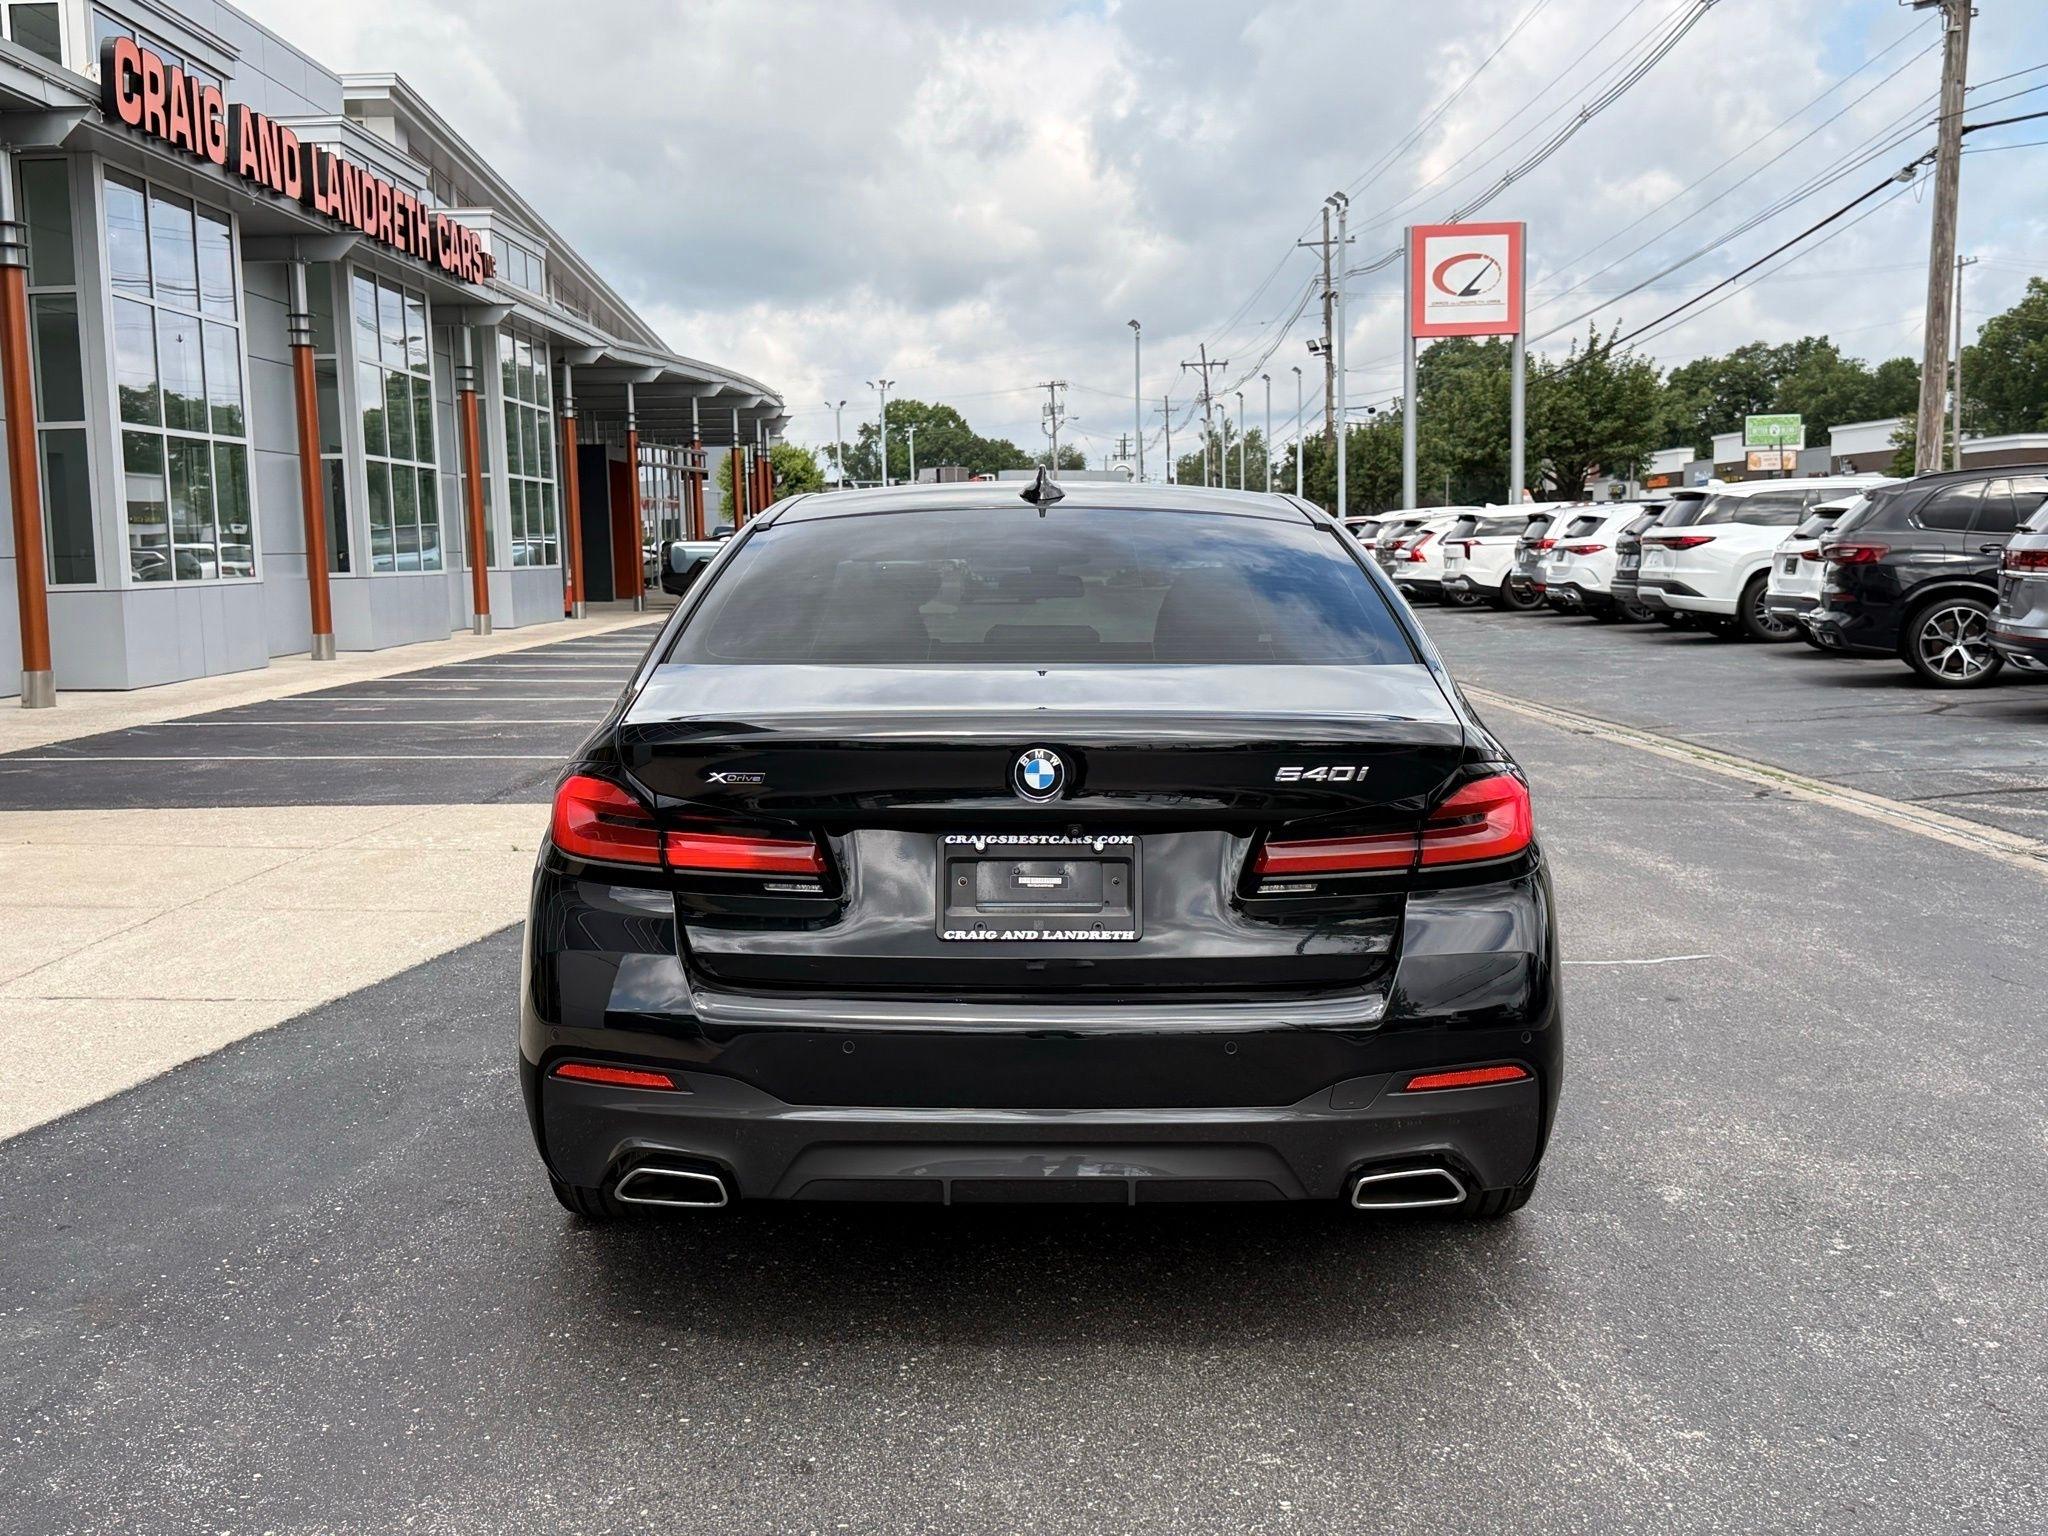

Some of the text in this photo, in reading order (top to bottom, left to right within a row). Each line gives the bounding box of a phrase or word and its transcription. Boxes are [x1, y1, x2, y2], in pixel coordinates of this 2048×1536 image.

[113, 36, 226, 165] CRAIG
[239, 103, 301, 200] AND
[312, 143, 432, 262] LANDRETH
[436, 212, 484, 286] CARS
[1019, 750, 1061, 767] BMW
[1274, 766, 1370, 781] 540i
[944, 834, 1134, 845] CRAIGSBESTCARS.COM
[943, 930, 1136, 940] CRAIG AND LANDRETH
